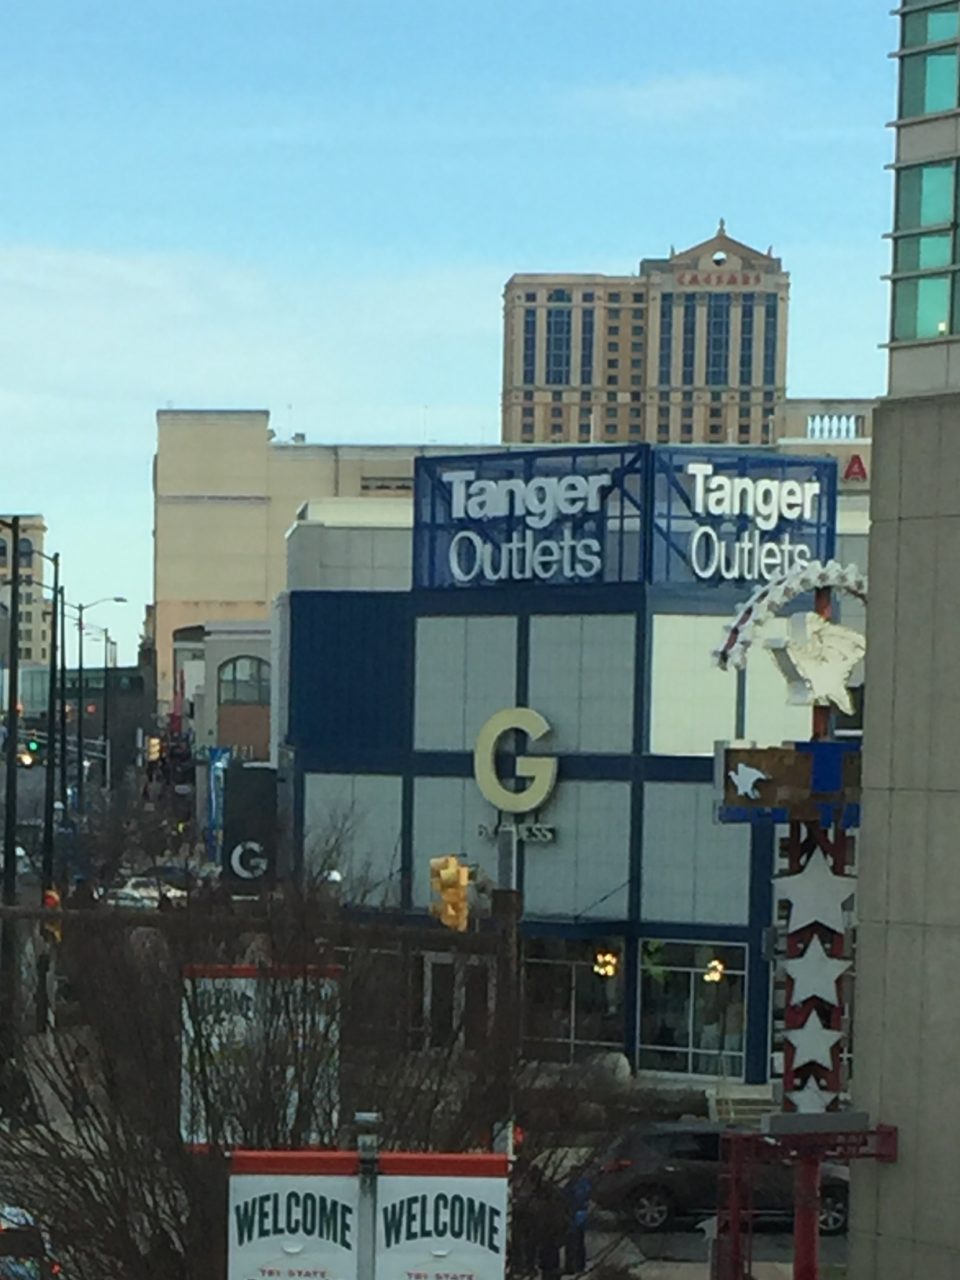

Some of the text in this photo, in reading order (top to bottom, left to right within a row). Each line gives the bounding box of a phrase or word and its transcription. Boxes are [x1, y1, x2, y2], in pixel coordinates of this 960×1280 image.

[442, 470, 611, 529] Tanger
[687, 463, 820, 531] Tanger
[449, 528, 602, 582] Outlets
[691, 525, 811, 581] Outlets
[474, 707, 559, 812] G
[230, 840, 268, 879] G
[235, 1190, 353, 1252] WELCOME
[382, 1192, 501, 1255] WELCOME
